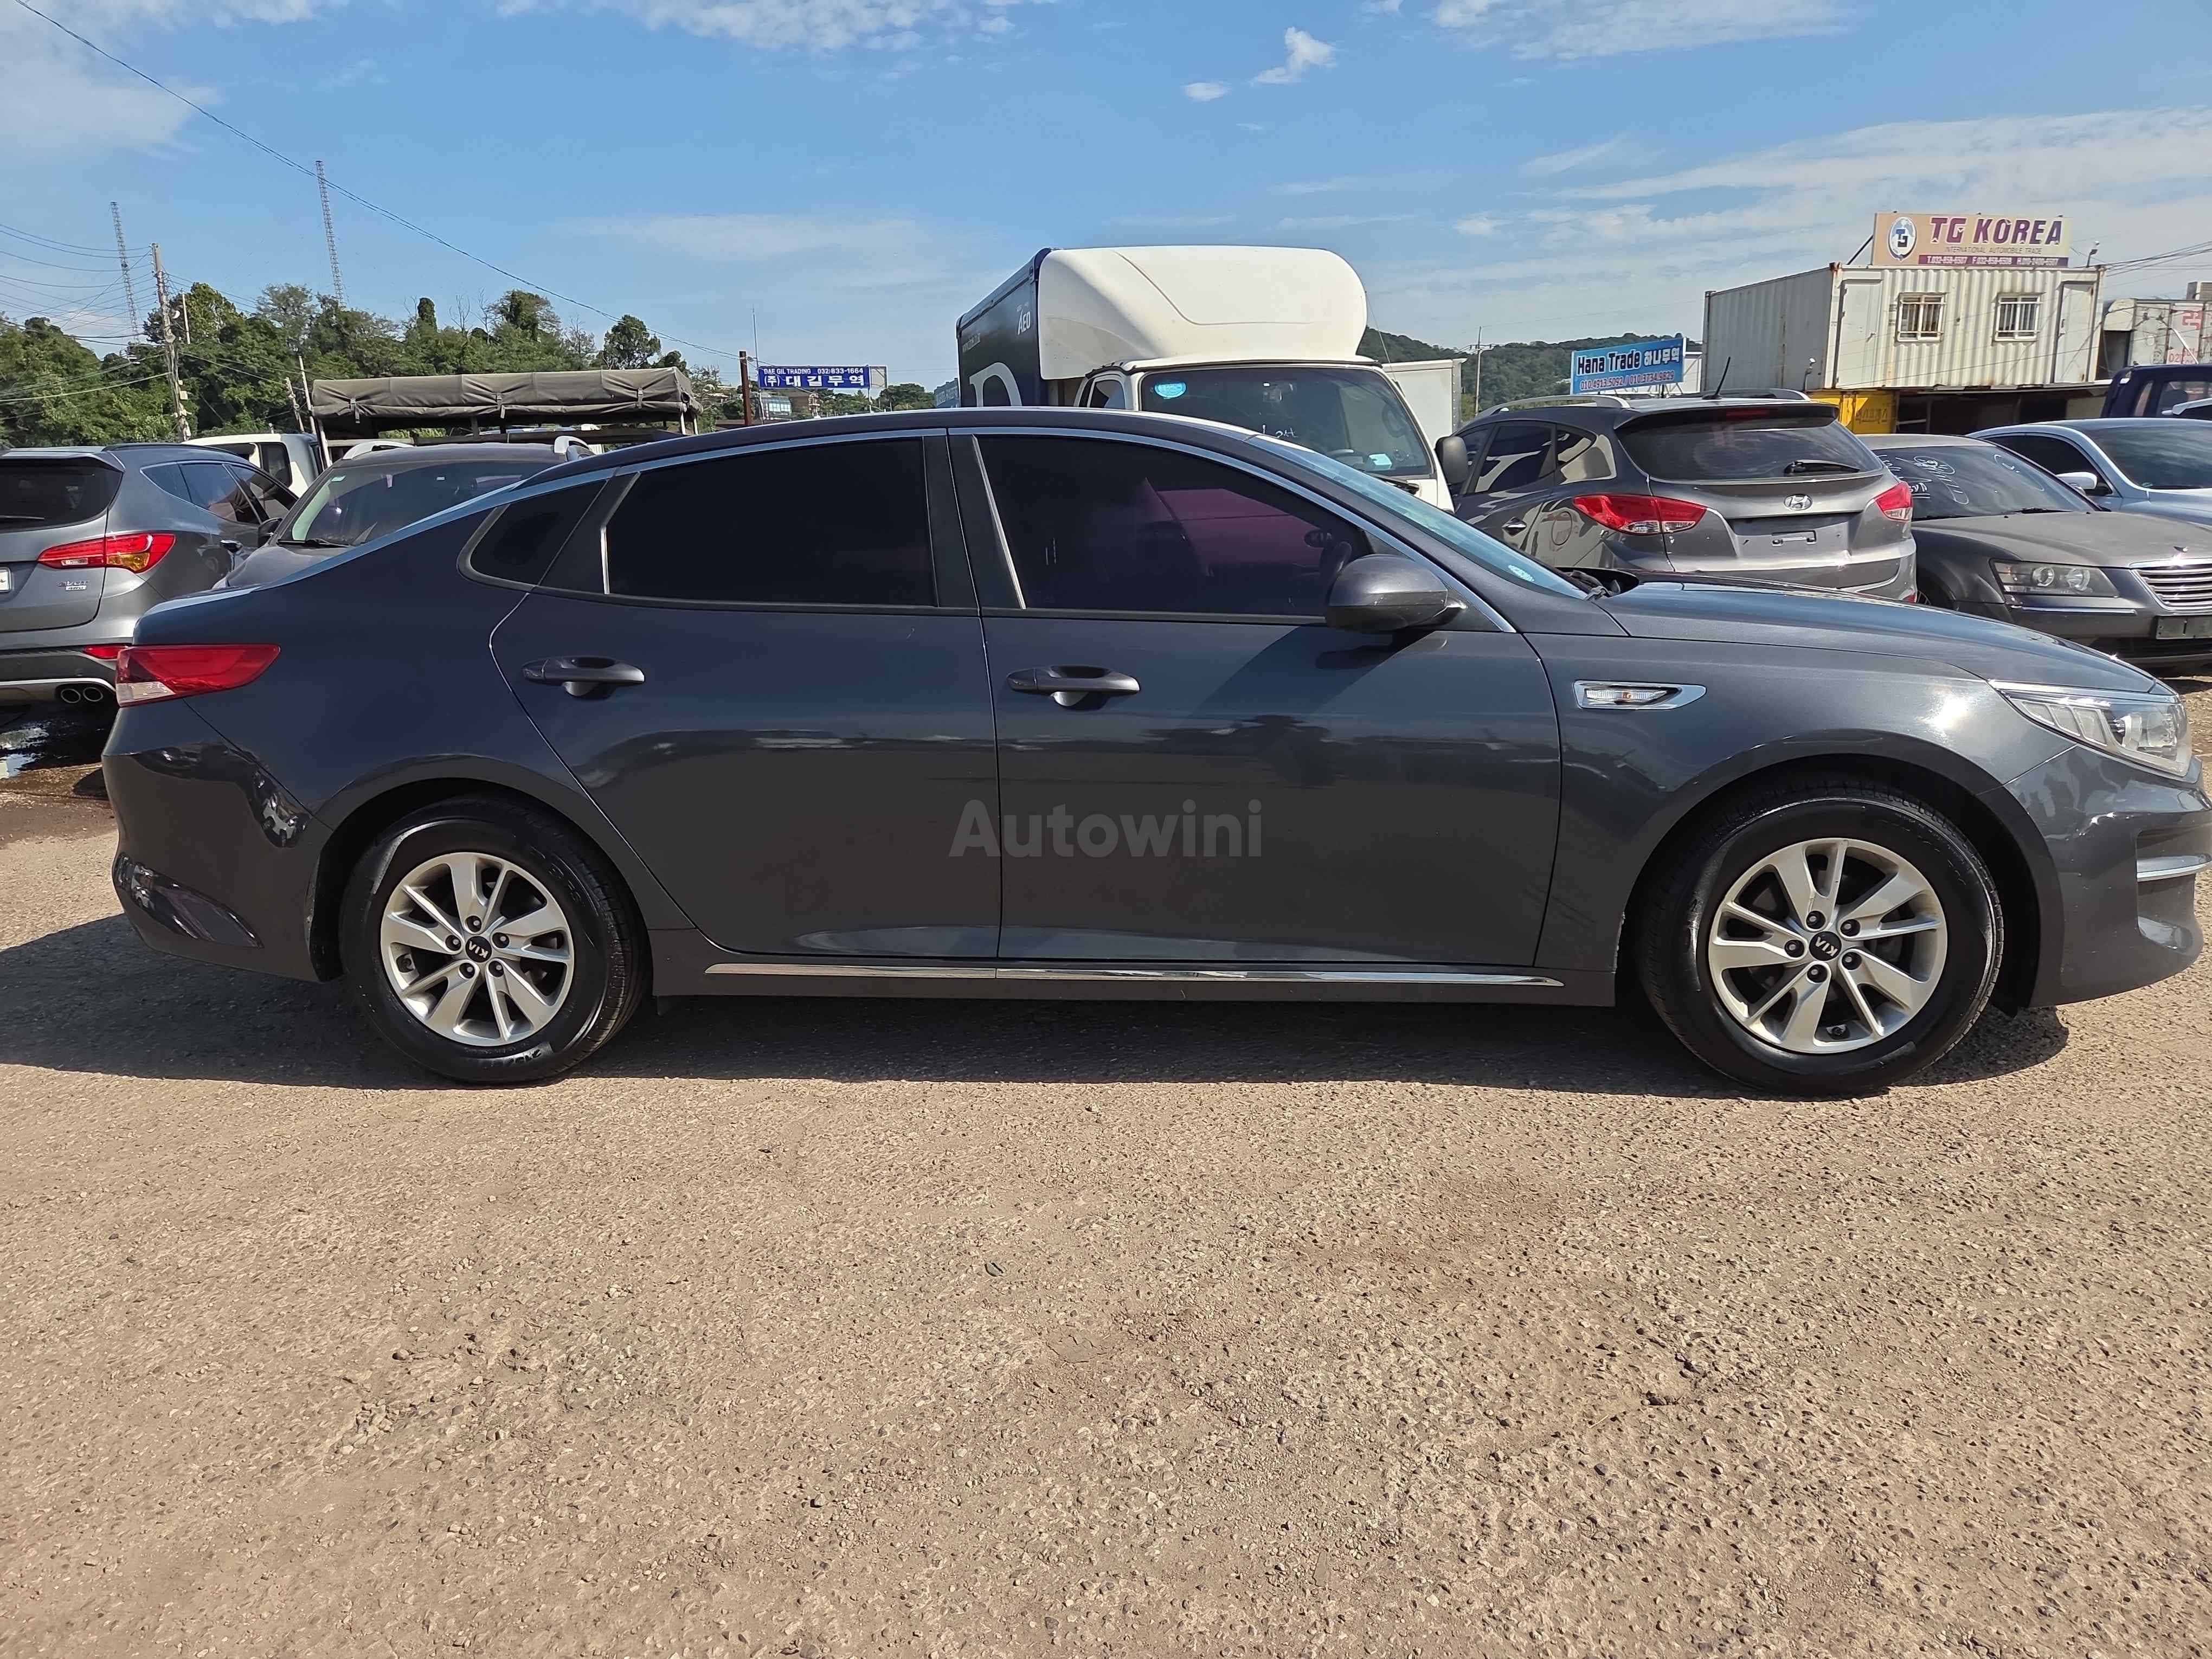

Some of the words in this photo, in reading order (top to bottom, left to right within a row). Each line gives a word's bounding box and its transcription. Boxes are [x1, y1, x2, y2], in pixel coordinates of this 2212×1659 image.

[1931, 217, 1966, 244] TG
[1972, 217, 2062, 245] KOREA
[1577, 355, 1605, 375] Hana
[1609, 350, 1641, 372] Trade
[1644, 347, 1680, 366] 하나무역
[764, 376, 780, 387] (주)
[468, 941, 488, 959] KIA
[1815, 936, 1838, 957] KIA
